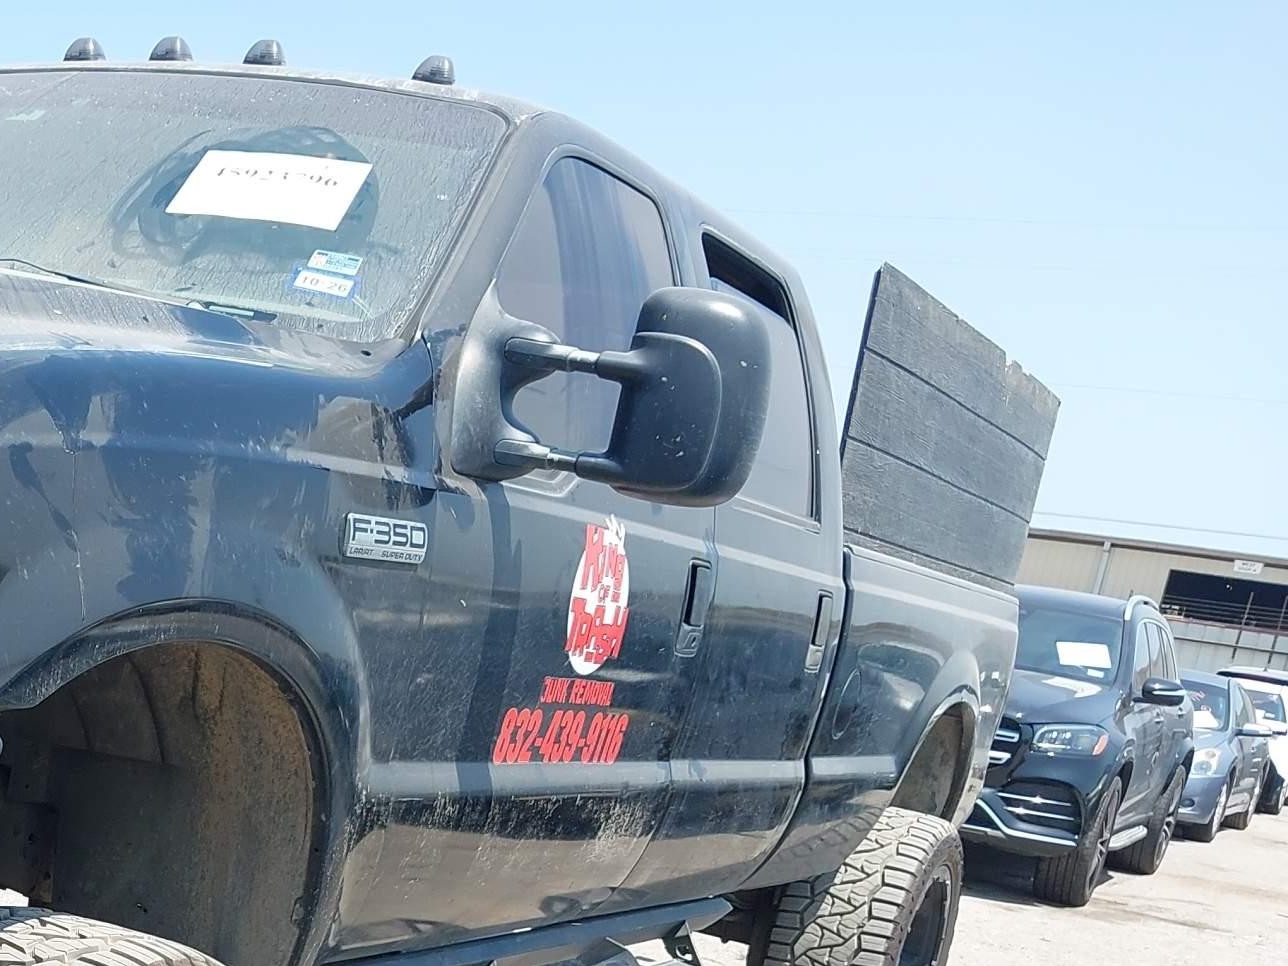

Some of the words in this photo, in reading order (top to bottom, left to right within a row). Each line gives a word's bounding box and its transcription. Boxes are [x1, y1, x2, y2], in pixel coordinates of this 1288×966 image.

[405, 553, 423, 562] DUTY
[540, 675, 571, 704] JUNK
[568, 678, 615, 706] REMOVAL
[493, 707, 629, 765] 832-439-9116
